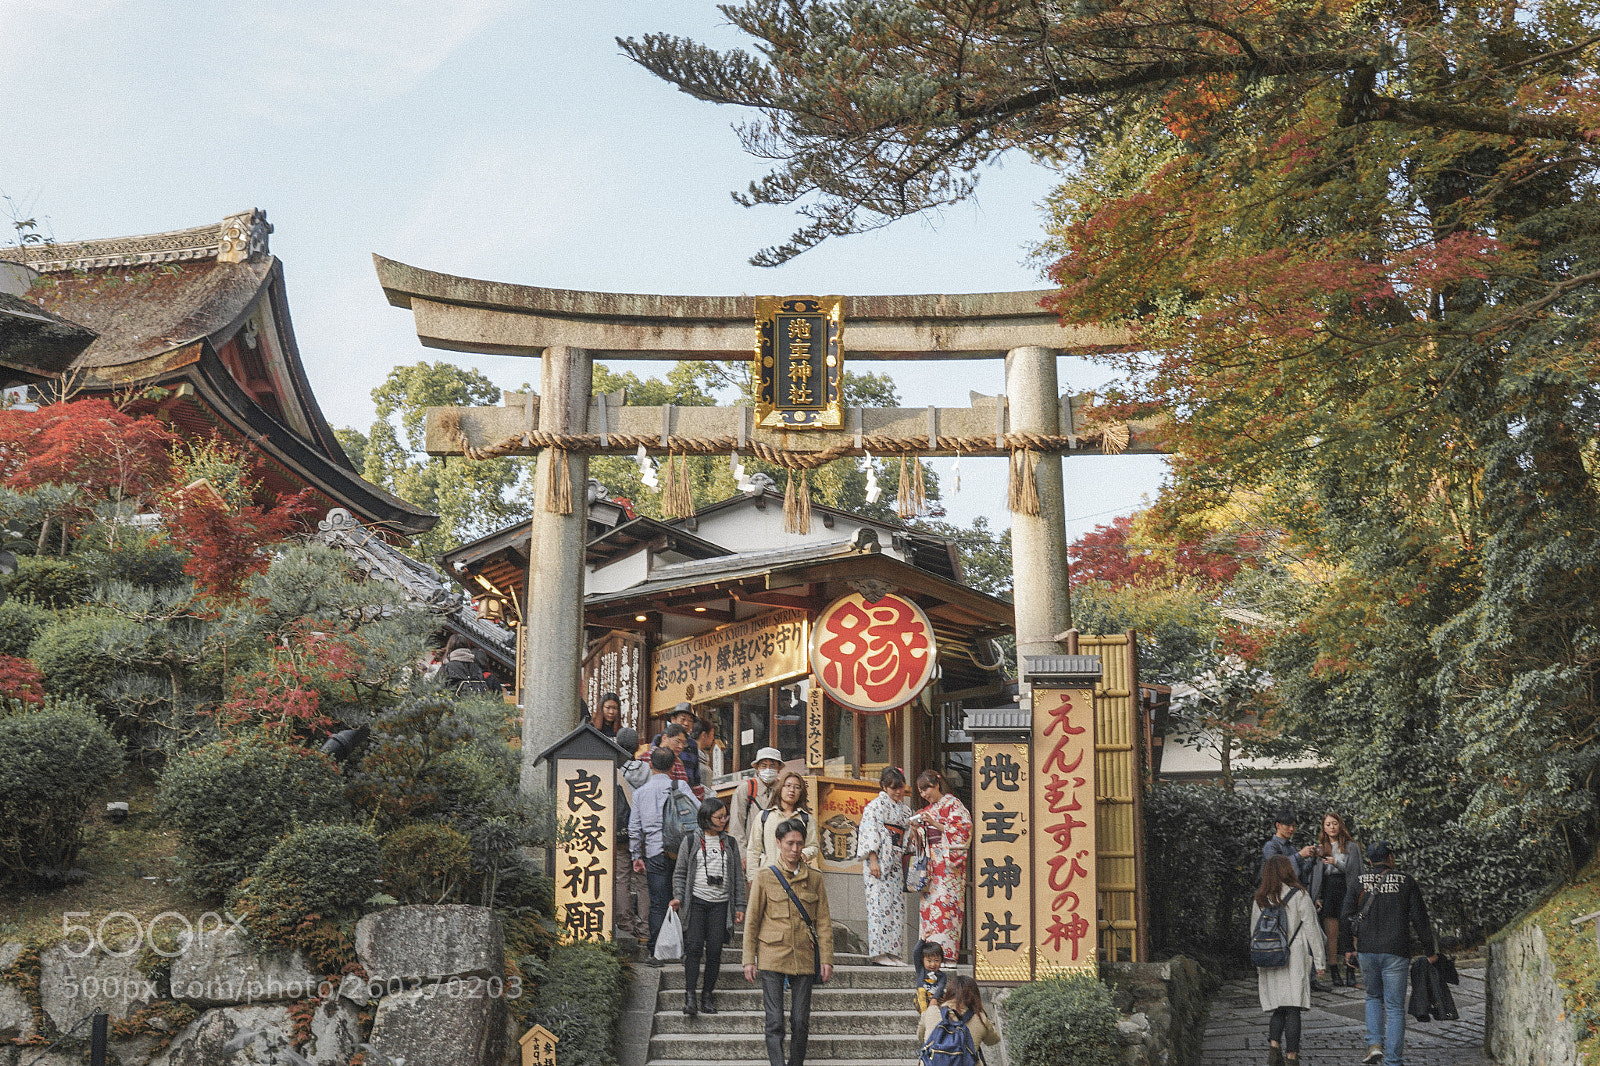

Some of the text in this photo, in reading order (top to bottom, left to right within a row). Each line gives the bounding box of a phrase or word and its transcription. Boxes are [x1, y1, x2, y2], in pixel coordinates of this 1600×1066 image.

[655, 651, 711, 692] 恋のお守り
[716, 623, 801, 673] 縁結びお守り
[674, 642, 691, 658] LUCK
[693, 631, 723, 651] CHARMS
[725, 622, 749, 642] KYOTO
[773, 607, 802, 626] SHRINE
[819, 593, 928, 703] 縁
[562, 768, 608, 942] 良縁祈願
[979, 752, 1023, 952] 地主神社
[1042, 693, 1089, 961] えんむすびの神
[1375, 873, 1406, 884] GILTY
